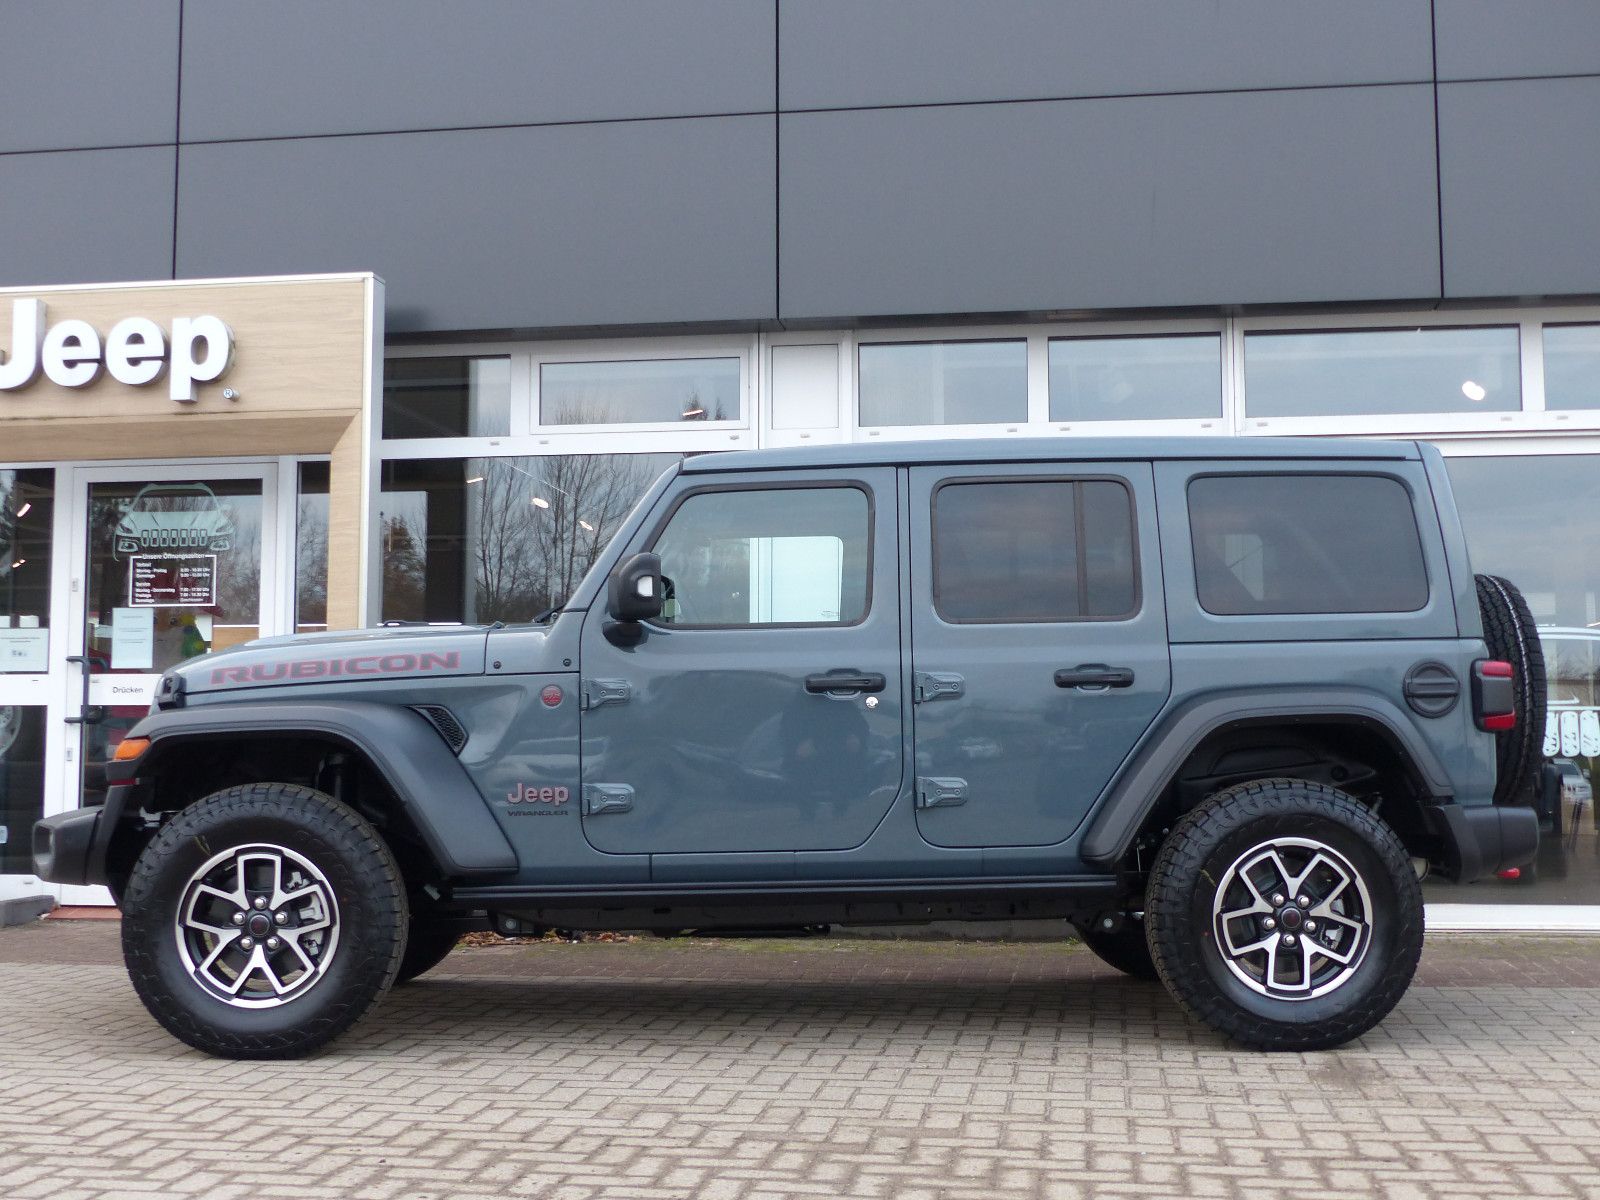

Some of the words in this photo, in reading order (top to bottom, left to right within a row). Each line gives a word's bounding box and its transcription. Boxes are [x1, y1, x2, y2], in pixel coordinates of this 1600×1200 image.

[0, 298, 235, 402] Jeep
[211, 650, 461, 685] RUBICON
[112, 686, 144, 694] Drücken
[507, 782, 569, 806] Jeep
